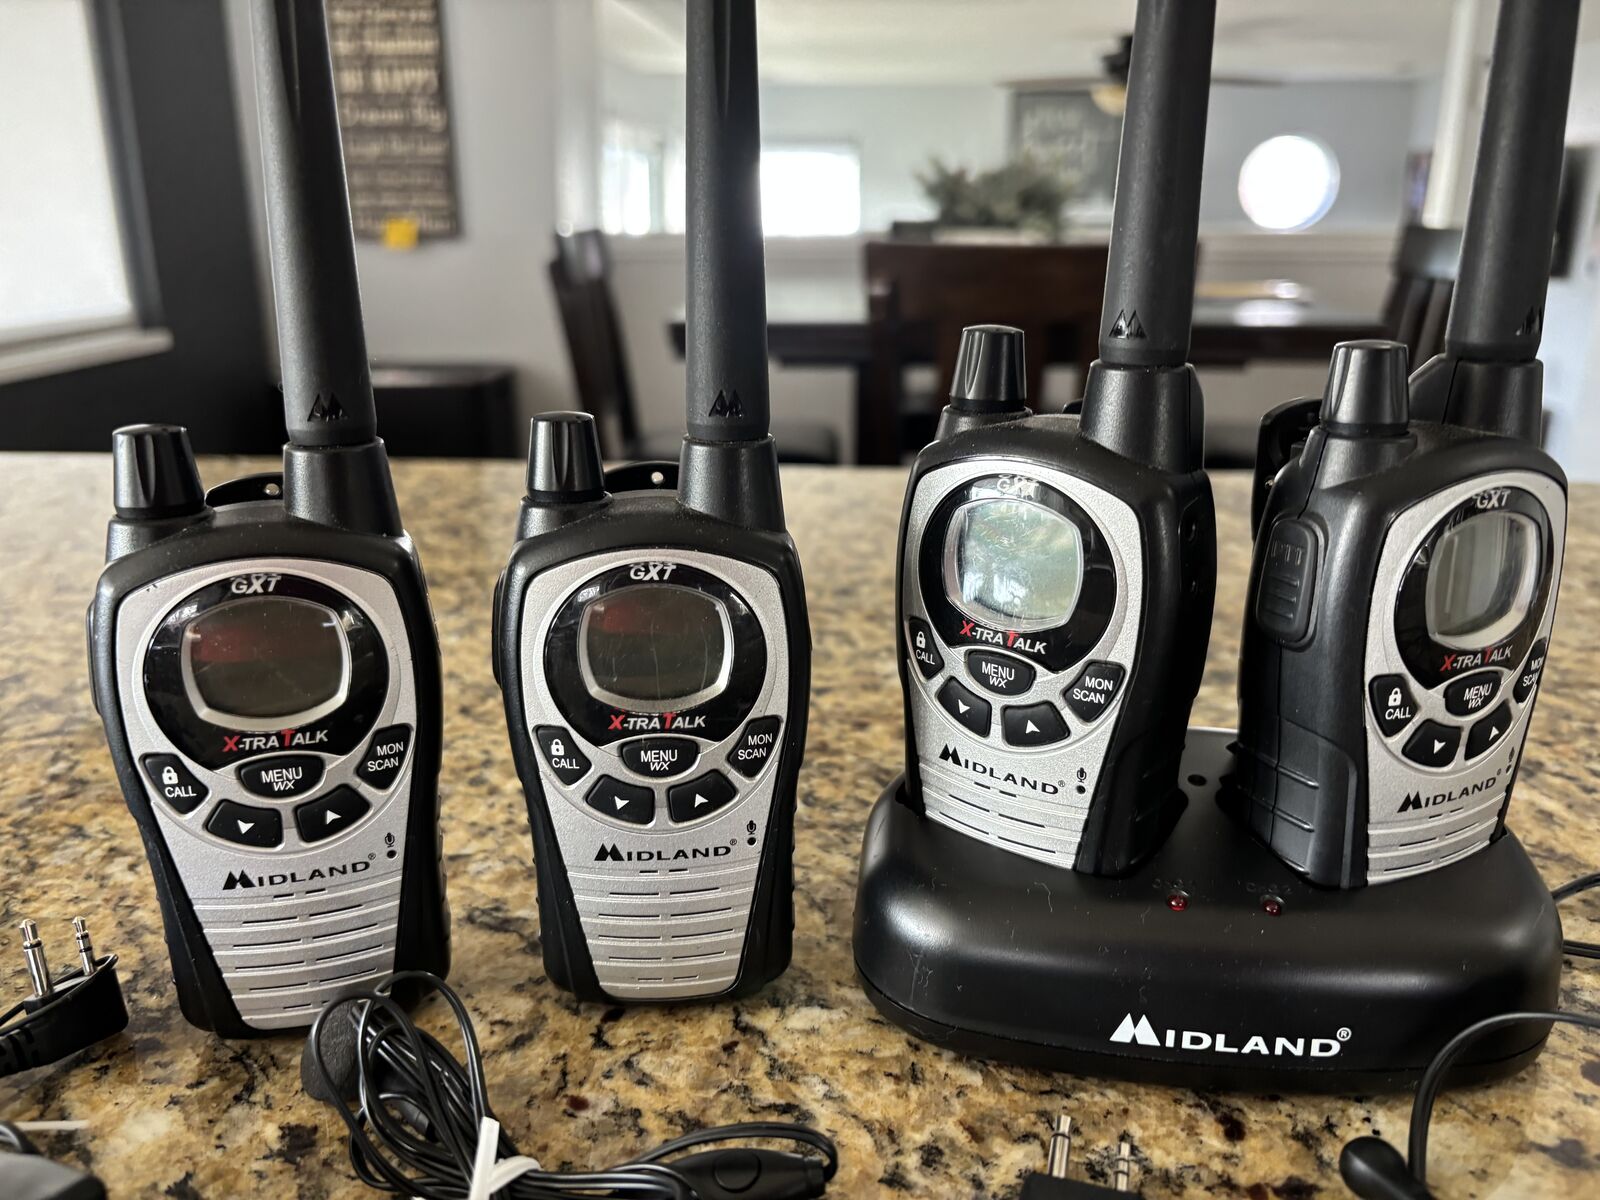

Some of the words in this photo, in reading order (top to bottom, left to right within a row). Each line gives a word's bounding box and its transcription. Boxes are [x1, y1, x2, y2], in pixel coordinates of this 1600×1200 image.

[1476, 489, 1511, 509] GXT
[630, 562, 677, 581] GXT
[231, 575, 281, 594] GXT
[915, 649, 935, 665] CALL
[981, 661, 1015, 681] MENU
[989, 675, 1008, 688] WX
[1084, 675, 1113, 691] MON
[1072, 688, 1105, 704] SCAN
[1463, 682, 1493, 700] MENU
[1468, 697, 1485, 707] WX
[1385, 707, 1411, 720] CALL
[748, 733, 773, 745] MON
[376, 741, 404, 756] MON
[640, 749, 678, 763] MENU
[737, 747, 767, 760] SCAN
[367, 757, 399, 772] SCAN
[552, 757, 580, 769] CALL
[650, 760, 670, 771] WX
[261, 766, 303, 784] MENU
[164, 786, 197, 798] CALL
[273, 780, 295, 791] WX
